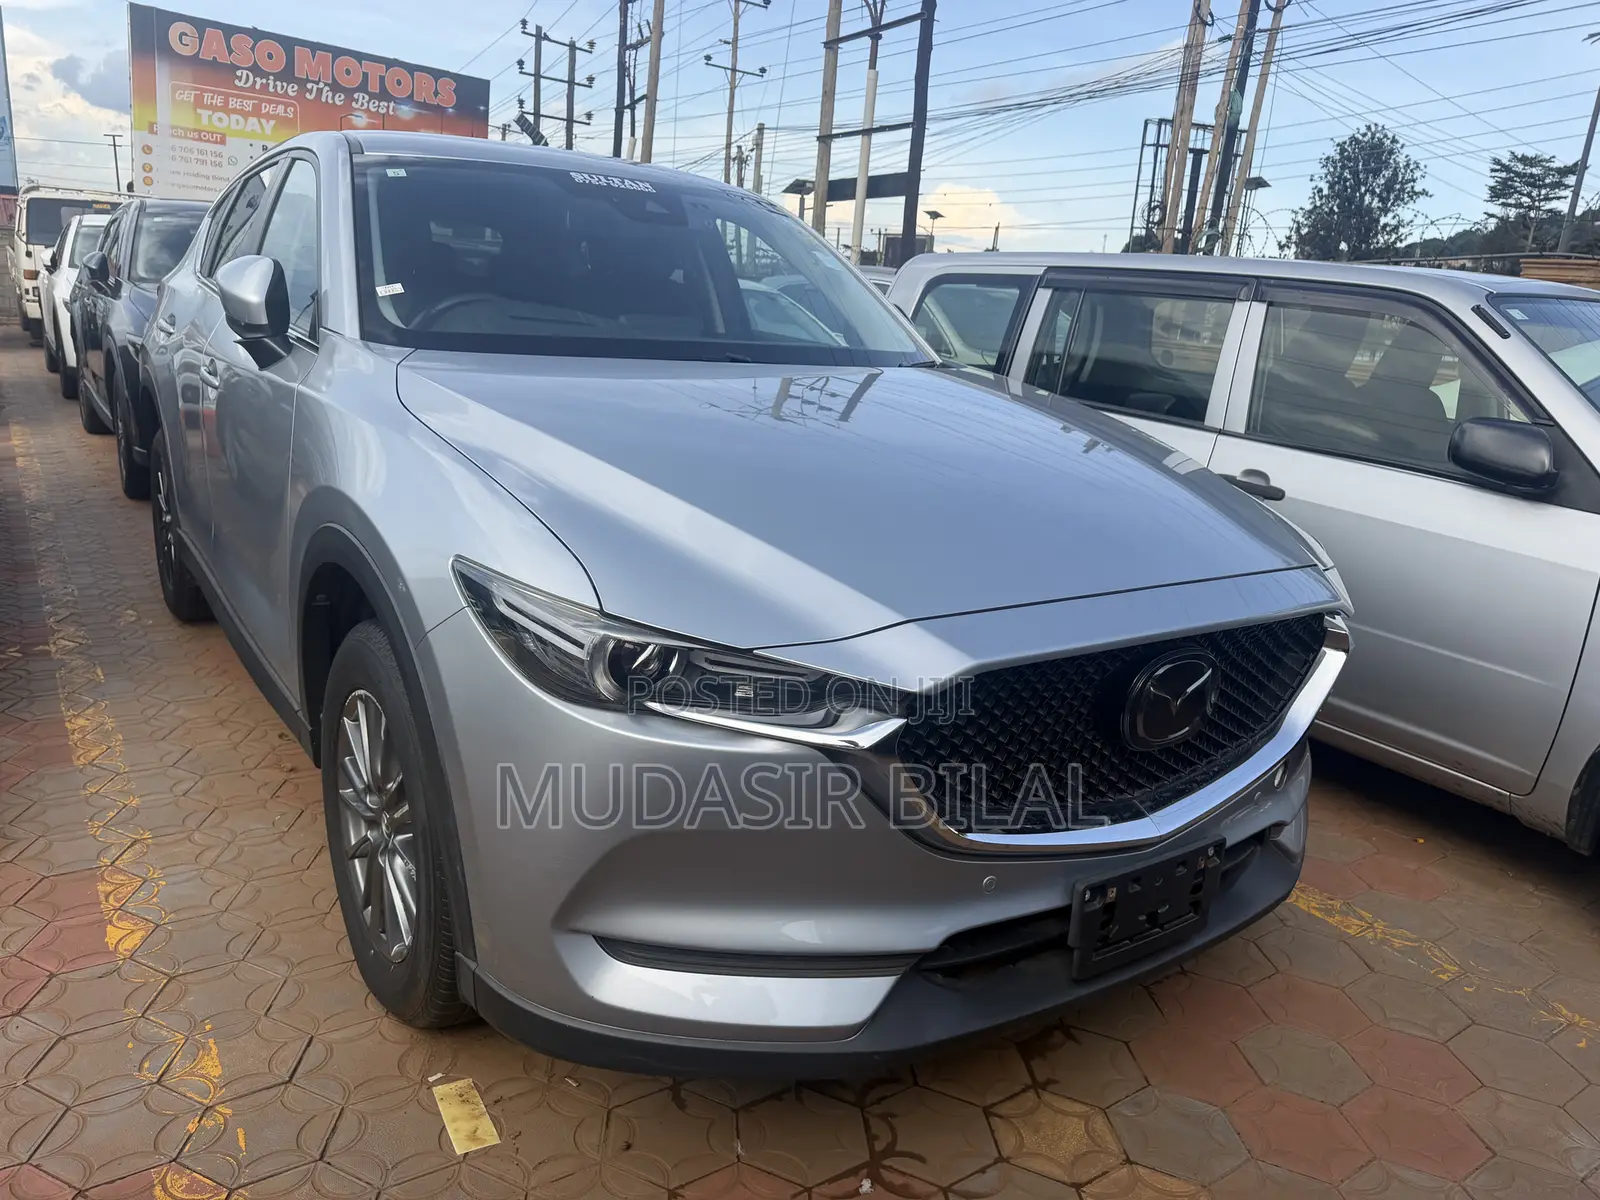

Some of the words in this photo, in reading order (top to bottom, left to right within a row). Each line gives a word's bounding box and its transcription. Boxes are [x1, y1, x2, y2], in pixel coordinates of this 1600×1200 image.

[168, 21, 286, 73] GASO
[294, 45, 457, 108] MOTORS
[175, 89, 200, 103] GET
[202, 92, 225, 107] THE
[228, 96, 258, 112] BEST
[261, 102, 294, 118] DEALS
[234, 69, 298, 97] Drive
[305, 82, 345, 106] The
[351, 92, 396, 116] Best
[187, 130, 199, 139] us
[200, 132, 222, 142] OUT
[196, 108, 277, 135] TODAY
